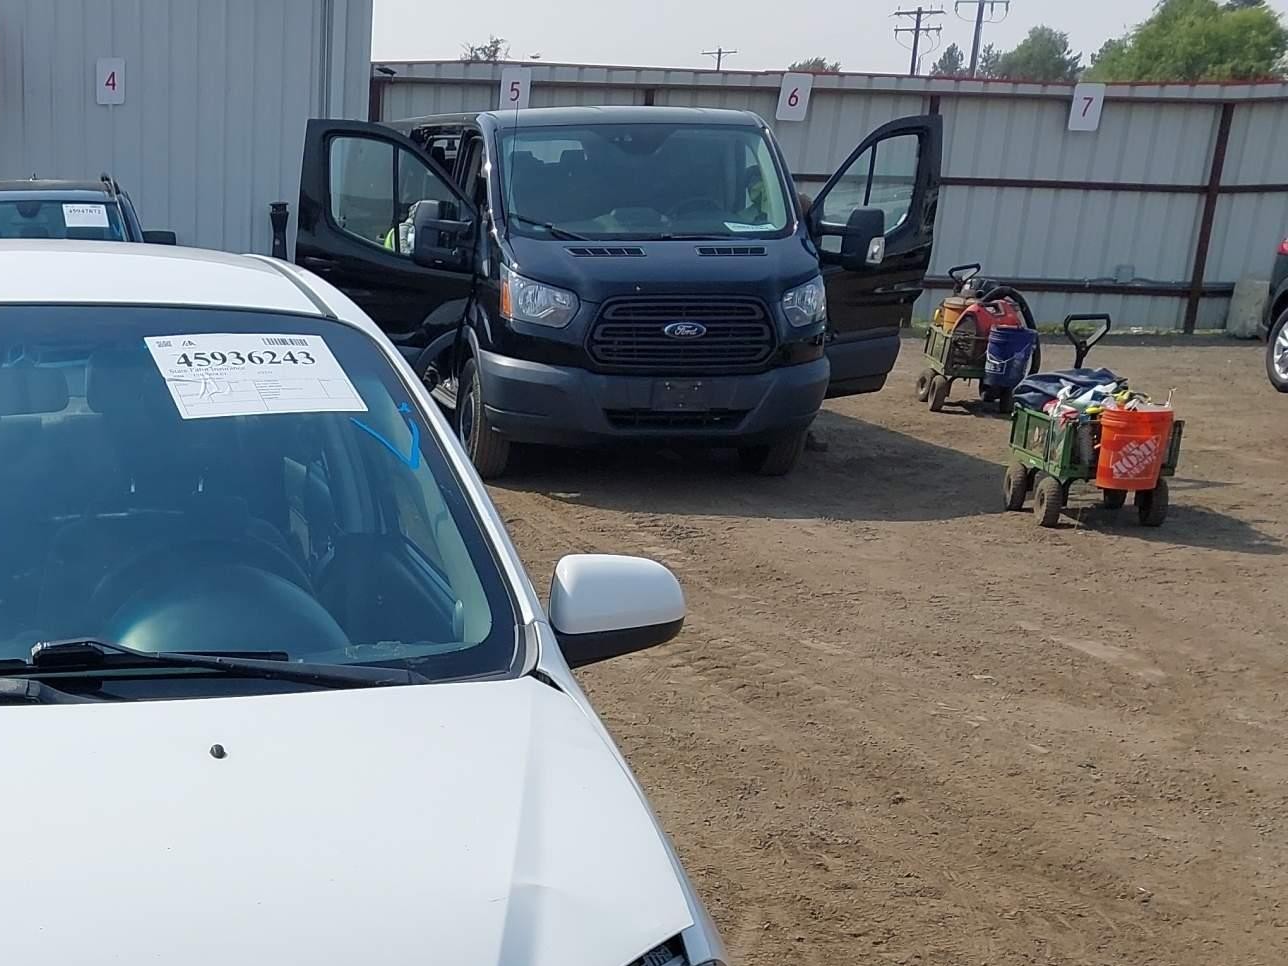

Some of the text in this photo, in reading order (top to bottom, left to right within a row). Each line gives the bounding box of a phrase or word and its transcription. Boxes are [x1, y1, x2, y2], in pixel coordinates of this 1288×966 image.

[105, 72, 117, 91] 4
[509, 81, 521, 101] 5
[787, 88, 800, 107] 6
[1081, 97, 1094, 117] 7
[176, 350, 316, 368] 45936243
[1112, 436, 1160, 473] HOME
